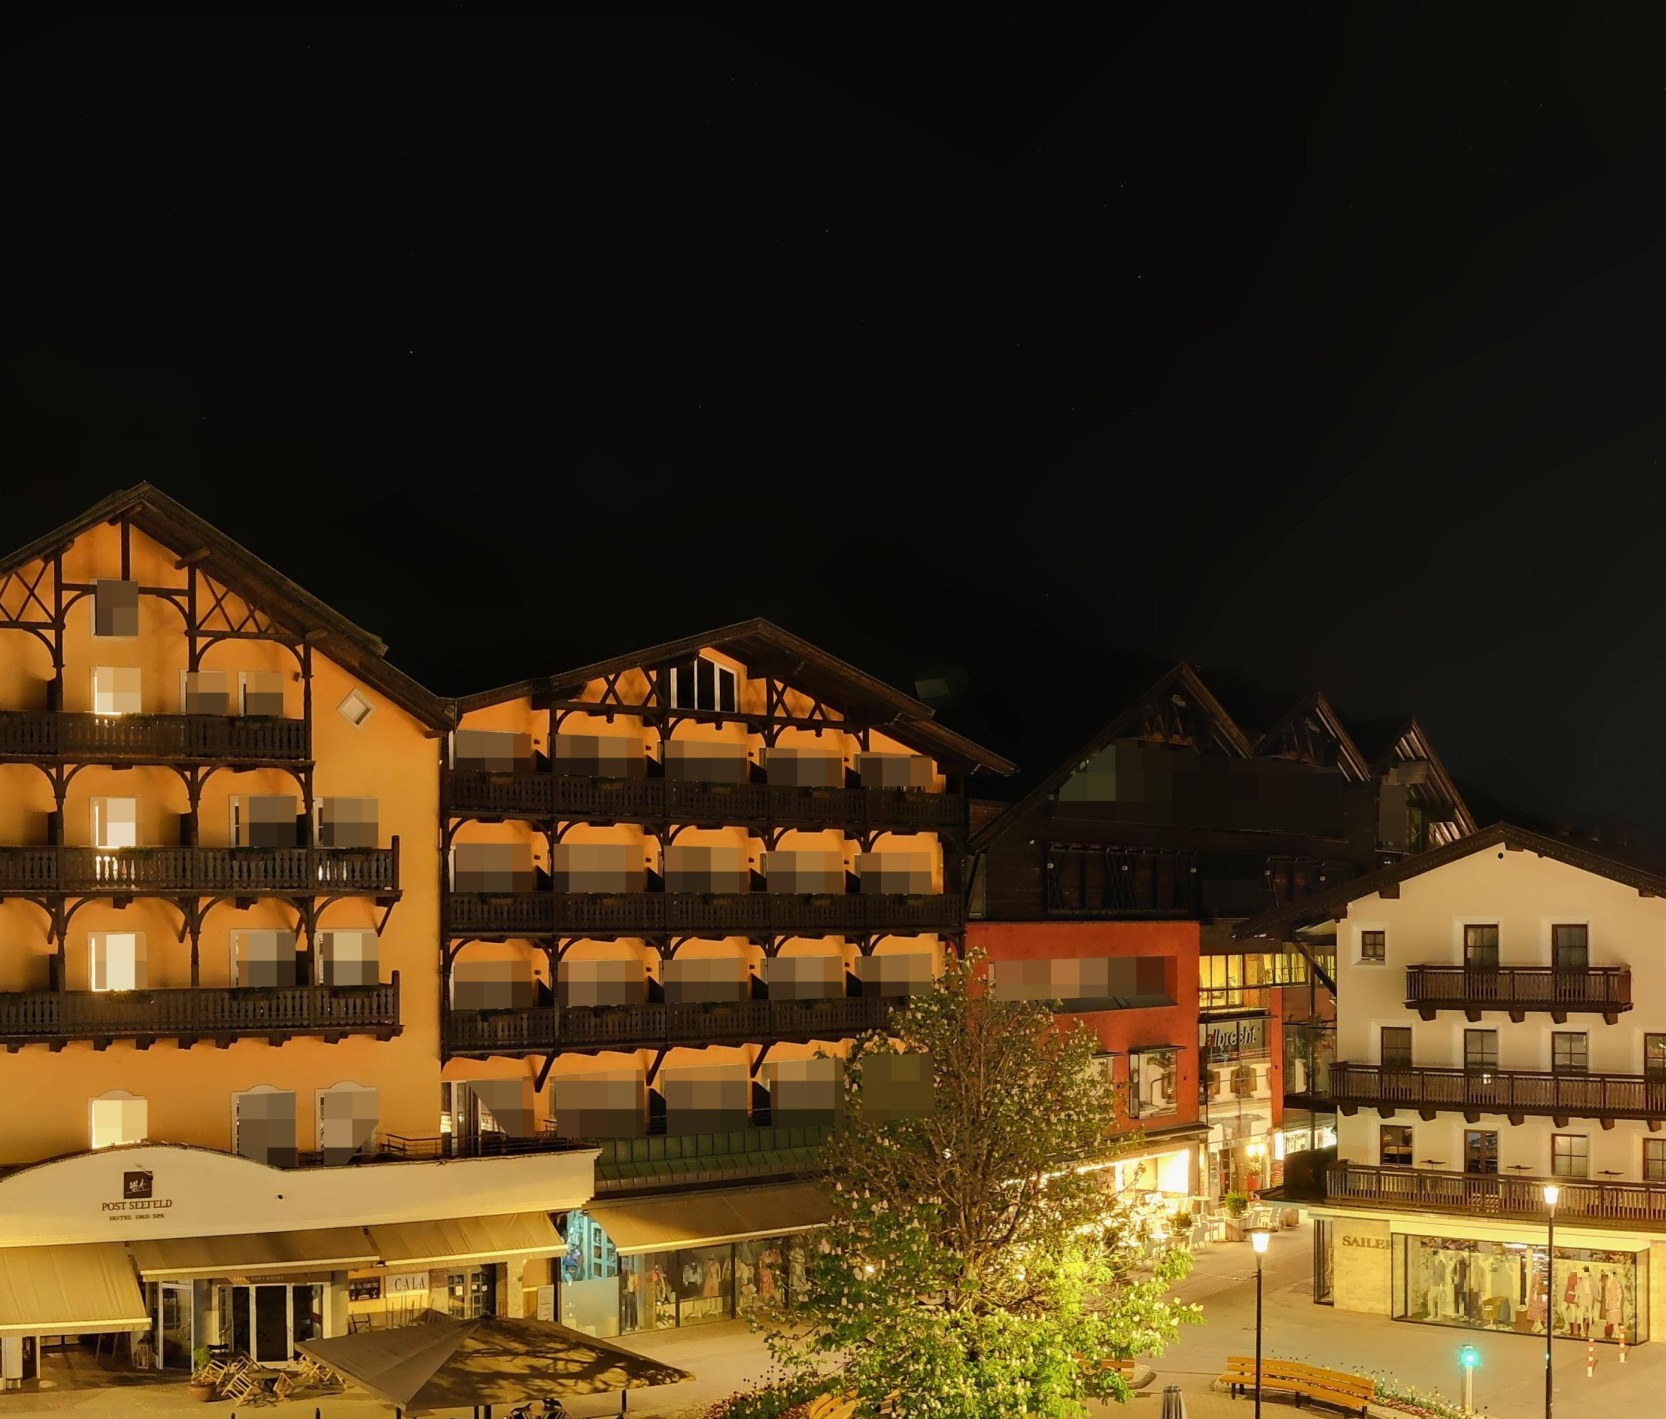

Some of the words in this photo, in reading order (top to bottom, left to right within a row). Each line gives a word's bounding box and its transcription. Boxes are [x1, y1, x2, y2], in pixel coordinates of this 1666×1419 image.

[101, 1201, 127, 1211] POST
[129, 1199, 173, 1210] SEEFELD
[394, 1276, 426, 1291] CALA
